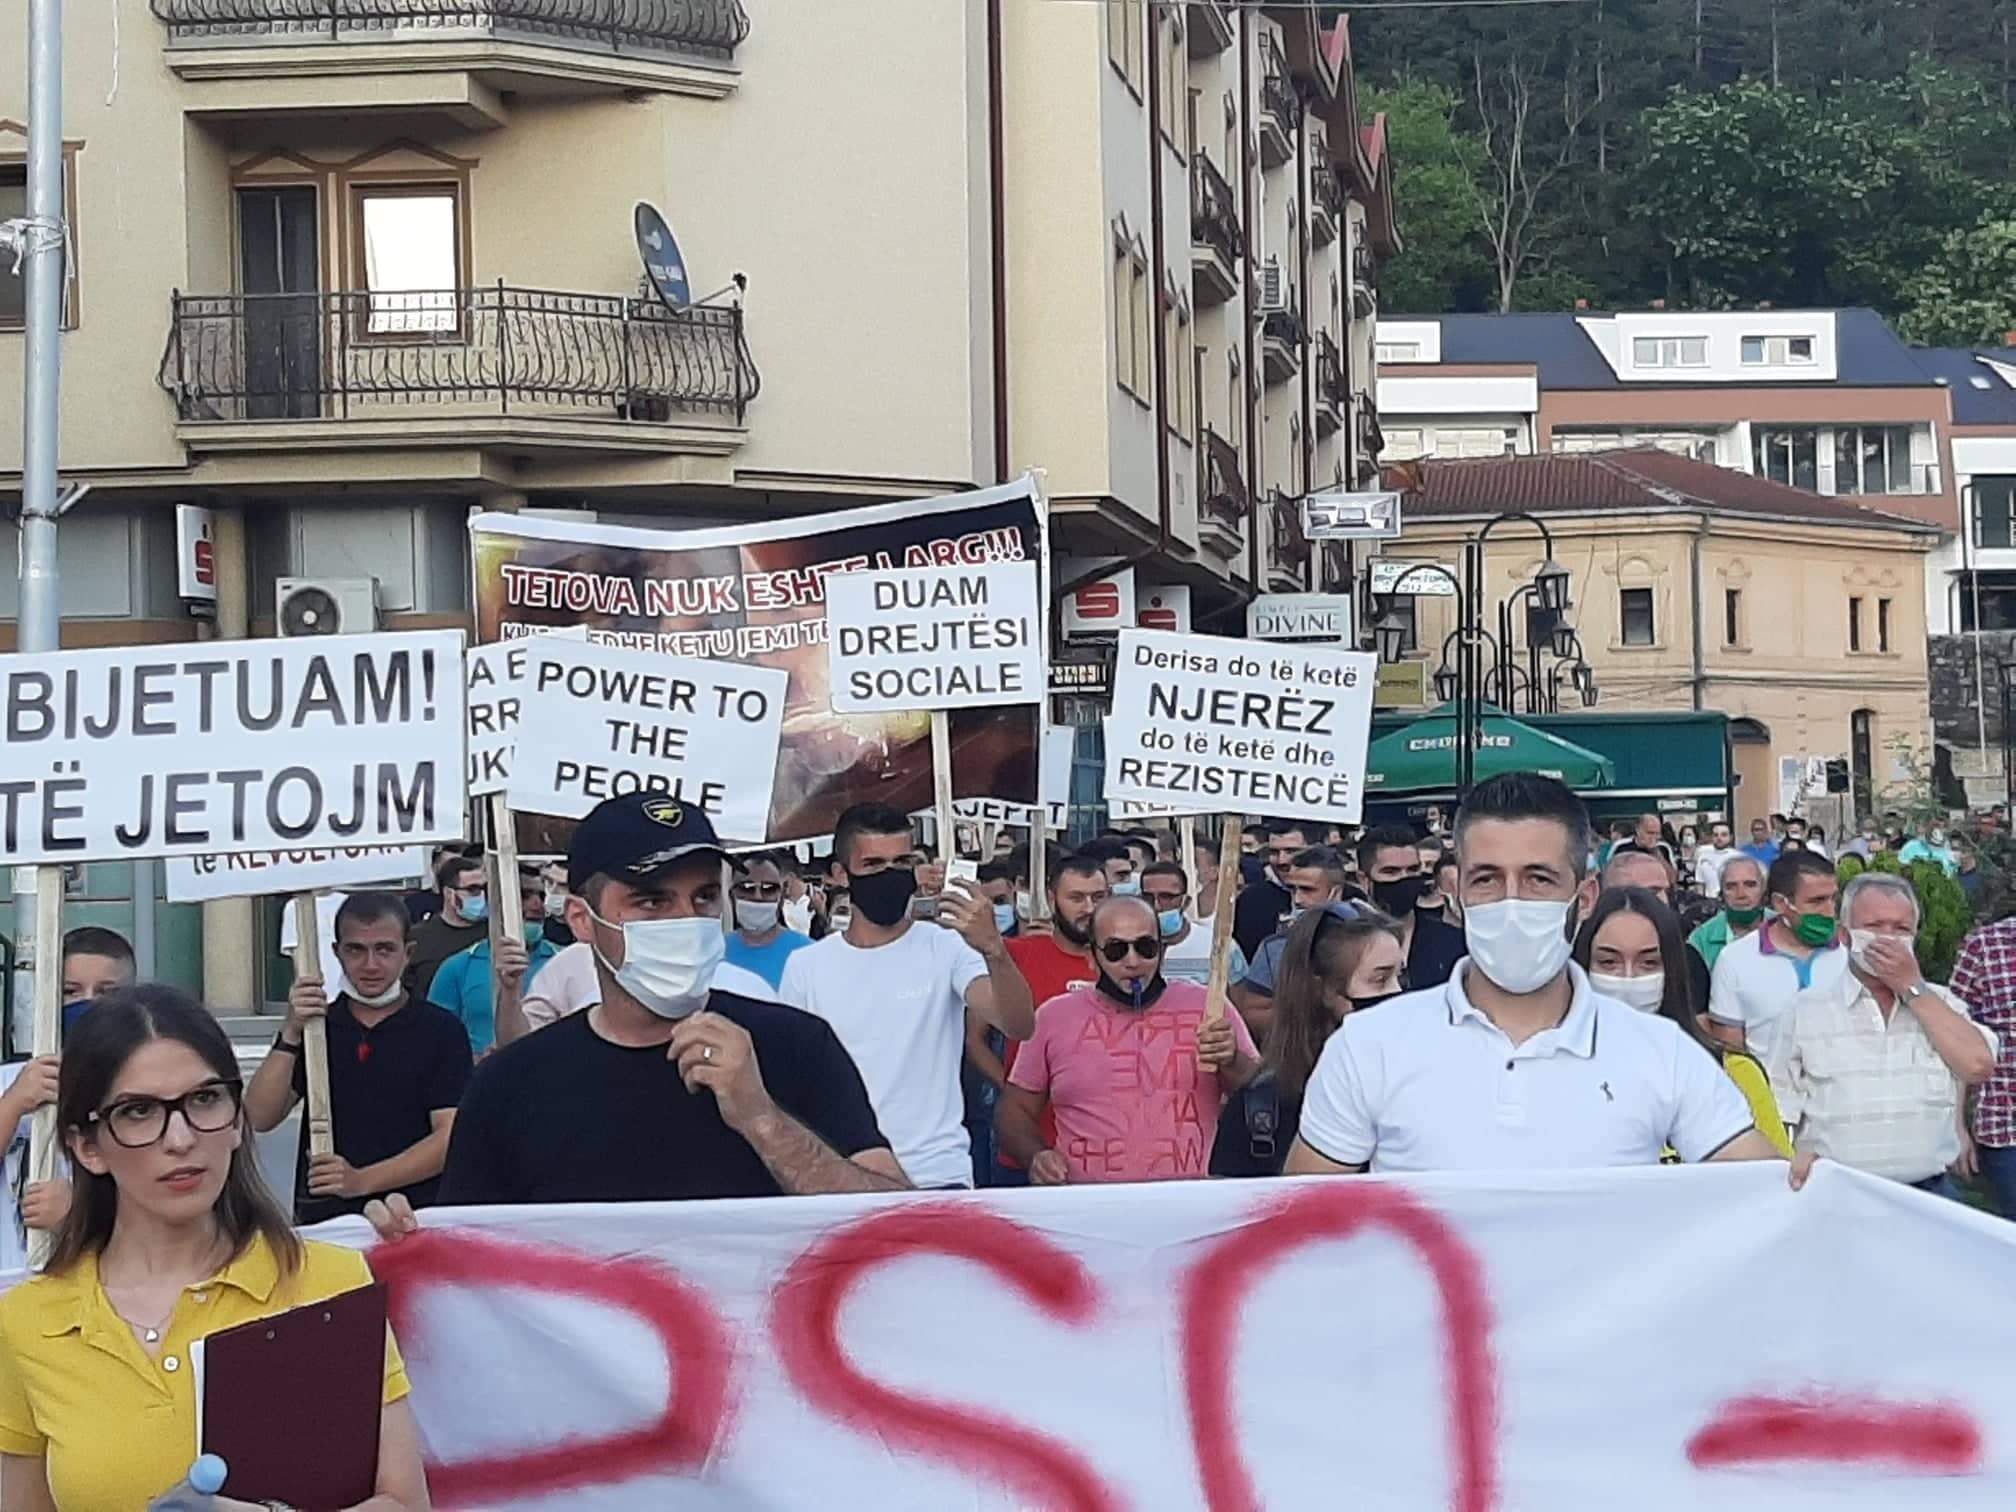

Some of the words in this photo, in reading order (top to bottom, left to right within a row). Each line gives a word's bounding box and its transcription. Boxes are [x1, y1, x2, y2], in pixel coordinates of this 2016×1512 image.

[502, 564, 639, 616] TETOVA
[645, 574, 739, 616] NUK
[874, 576, 988, 610] DUAM
[657, 630, 735, 658] KETU
[740, 624, 798, 661] JEMI
[840, 612, 1028, 656] DREJTËSI
[1256, 613, 1340, 634] DIVINE
[850, 663, 1022, 700] SOCIALE
[1135, 645, 1218, 674] Derisa
[1228, 655, 1260, 677] do
[1271, 659, 1293, 681] të
[1303, 662, 1357, 688] ketë
[7, 649, 435, 743] BIJETUAM!
[537, 661, 697, 714] POWER
[712, 684, 768, 723] TO
[1149, 683, 1335, 735] NJERËZ
[606, 719, 688, 760] THE
[1141, 728, 1174, 750] do
[1185, 732, 1208, 754] të
[1219, 734, 1275, 761] ketë
[1286, 743, 1335, 767] dhe
[1119, 758, 1348, 807] REZISTENCË
[0, 760, 87, 853] TË
[114, 761, 435, 848] JETOJM
